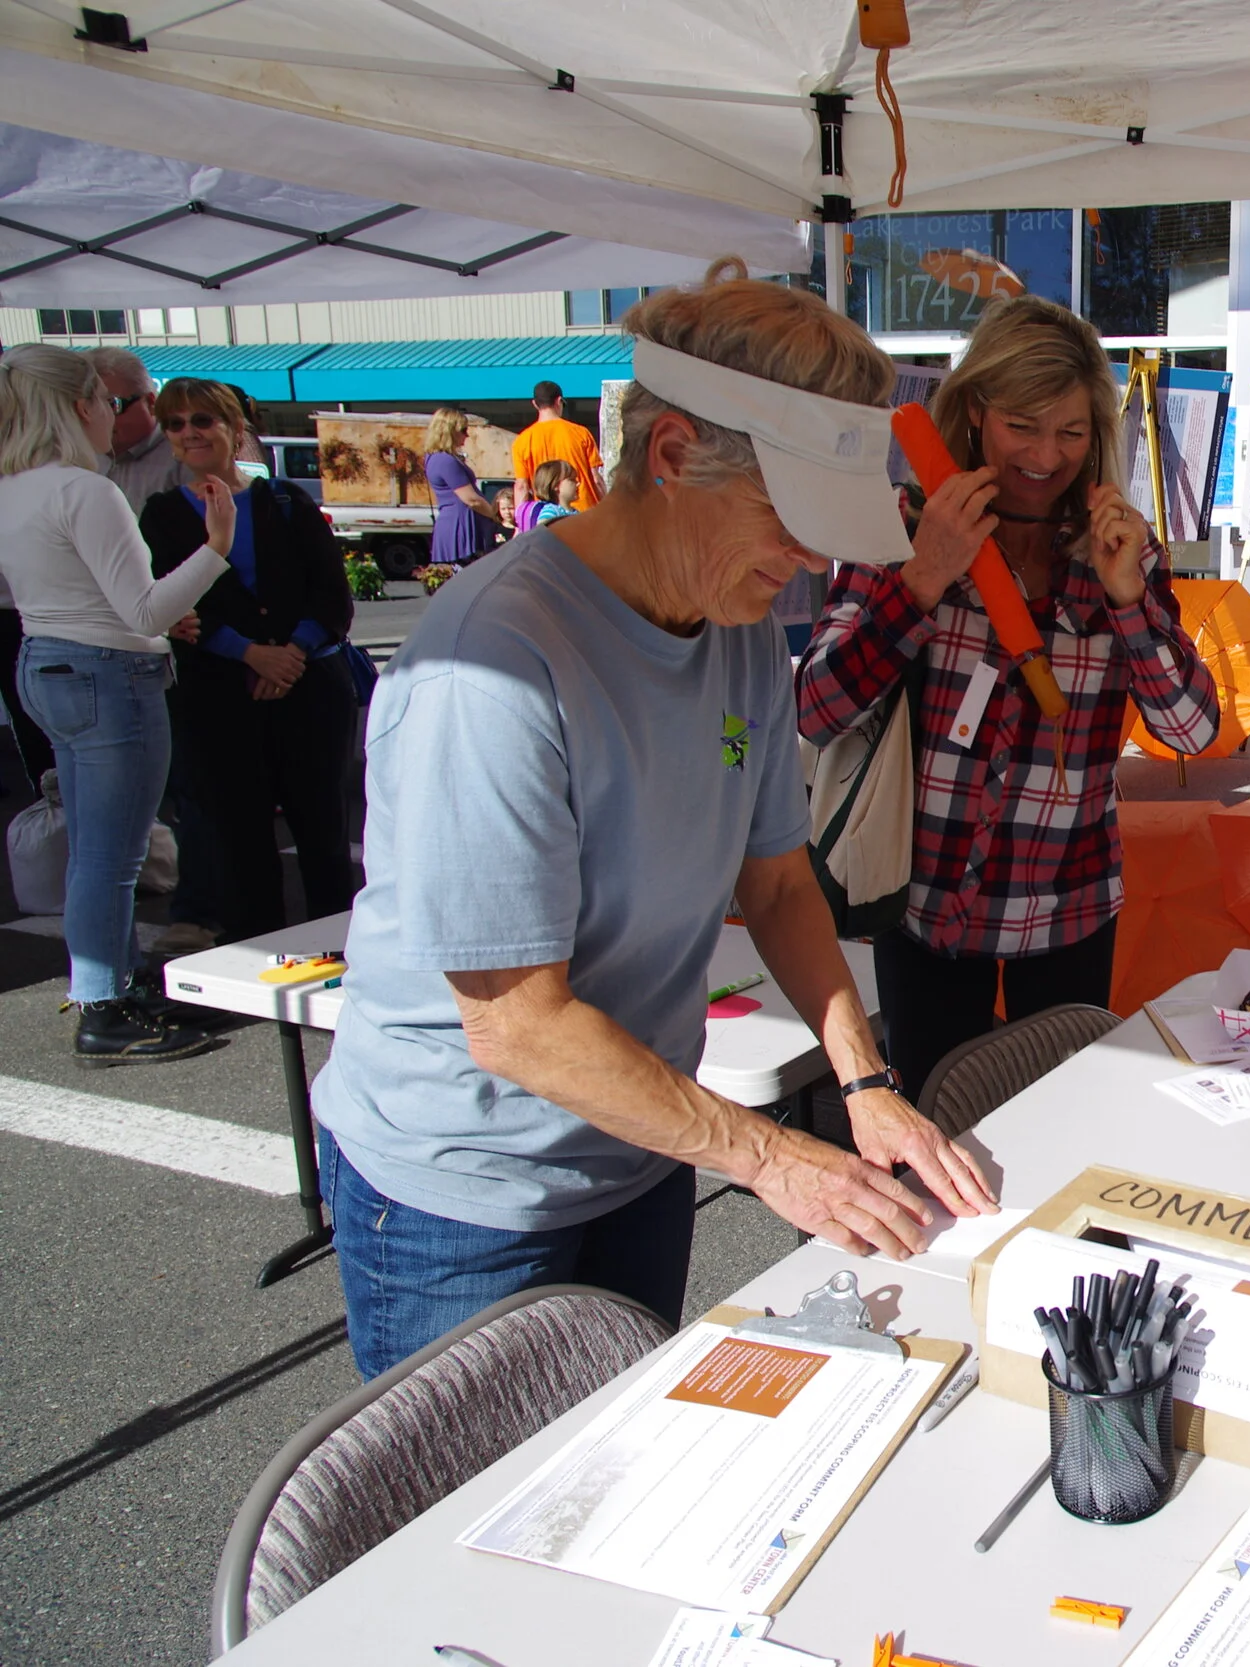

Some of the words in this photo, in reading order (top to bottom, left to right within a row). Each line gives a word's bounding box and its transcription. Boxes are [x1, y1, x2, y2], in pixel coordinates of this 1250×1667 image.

[852, 213, 903, 237] Lake
[913, 212, 994, 235] Forest
[1005, 209, 1065, 231] Park
[901, 240, 949, 273] City
[961, 235, 1008, 262] Hall
[897, 271, 1011, 322] 17425
[873, 1369, 912, 1410] NON-PROJECT
[864, 1412, 879, 1423] EIS
[839, 1425, 869, 1455] SCOPING
[808, 1458, 844, 1495] COMMENT
[788, 1497, 813, 1521] FORM
[761, 1548, 782, 1567] TOWN
[739, 1568, 766, 1594] CENTER
[1175, 1613, 1213, 1658] COMMENT
[1210, 1585, 1233, 1612] FORM
